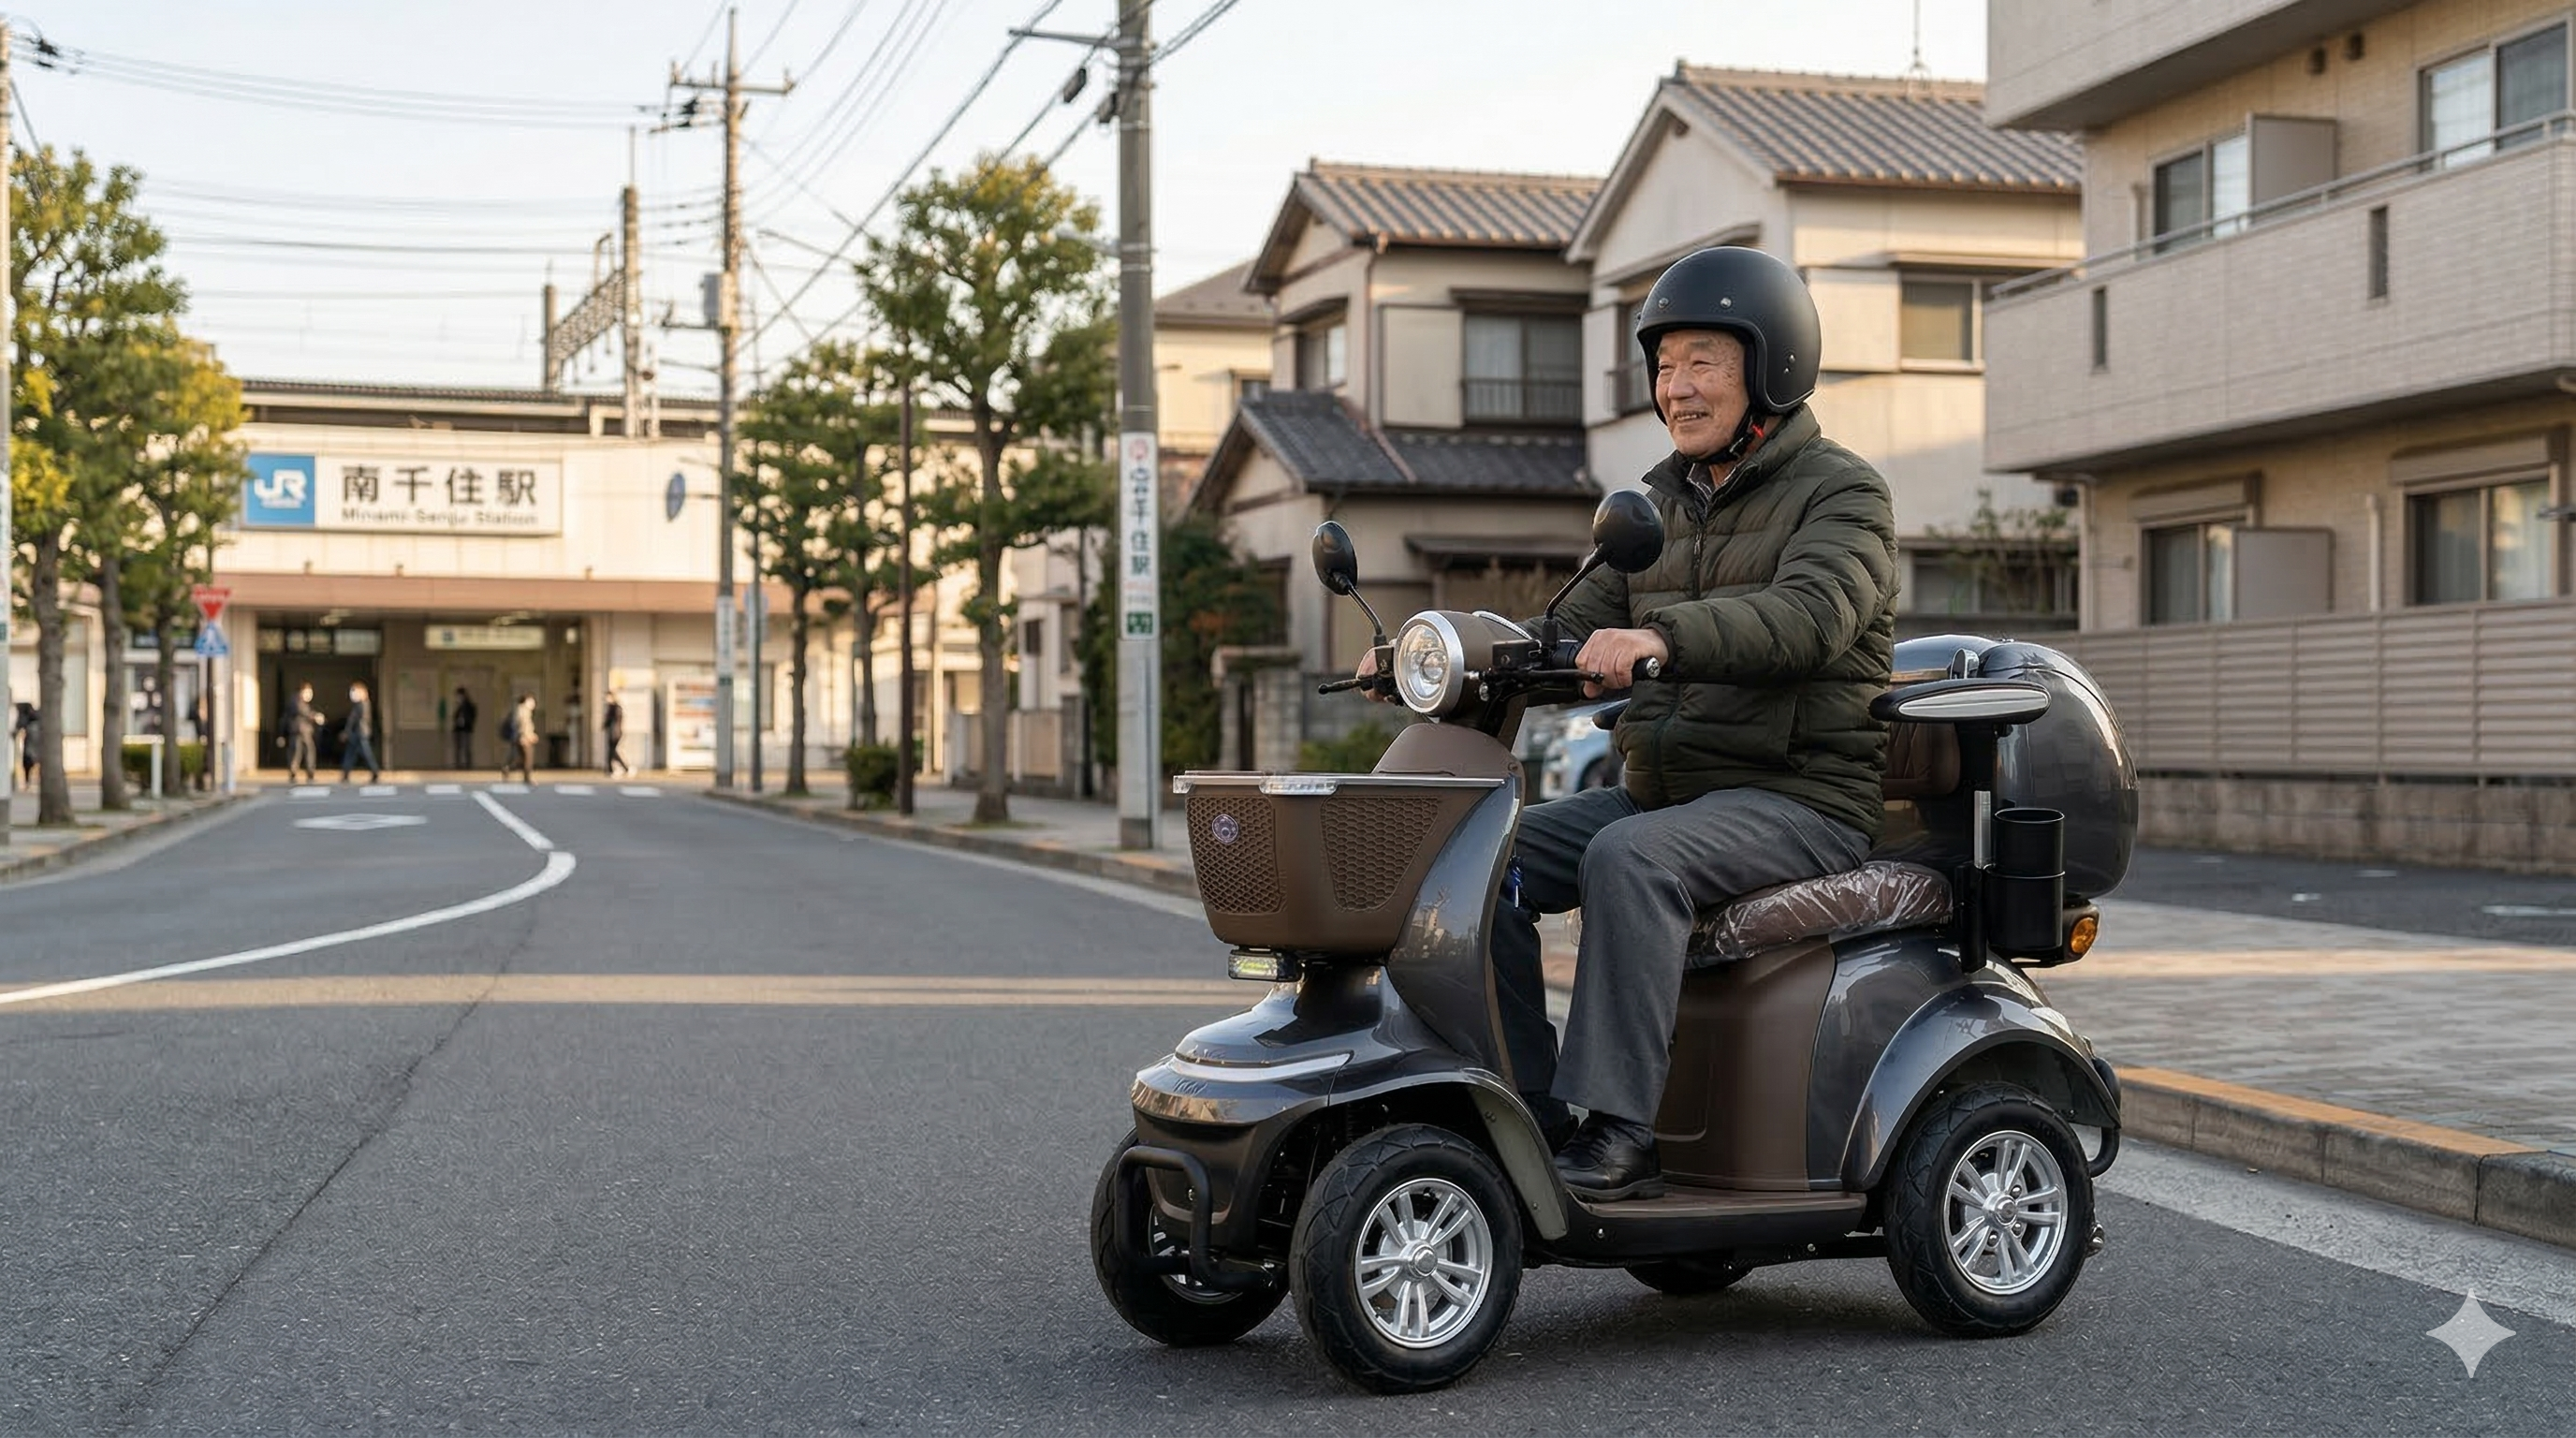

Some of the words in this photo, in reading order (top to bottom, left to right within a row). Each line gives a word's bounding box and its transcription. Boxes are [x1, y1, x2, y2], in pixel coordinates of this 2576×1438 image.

[254, 469, 307, 501] JR
[341, 464, 537, 506] 南千住駅
